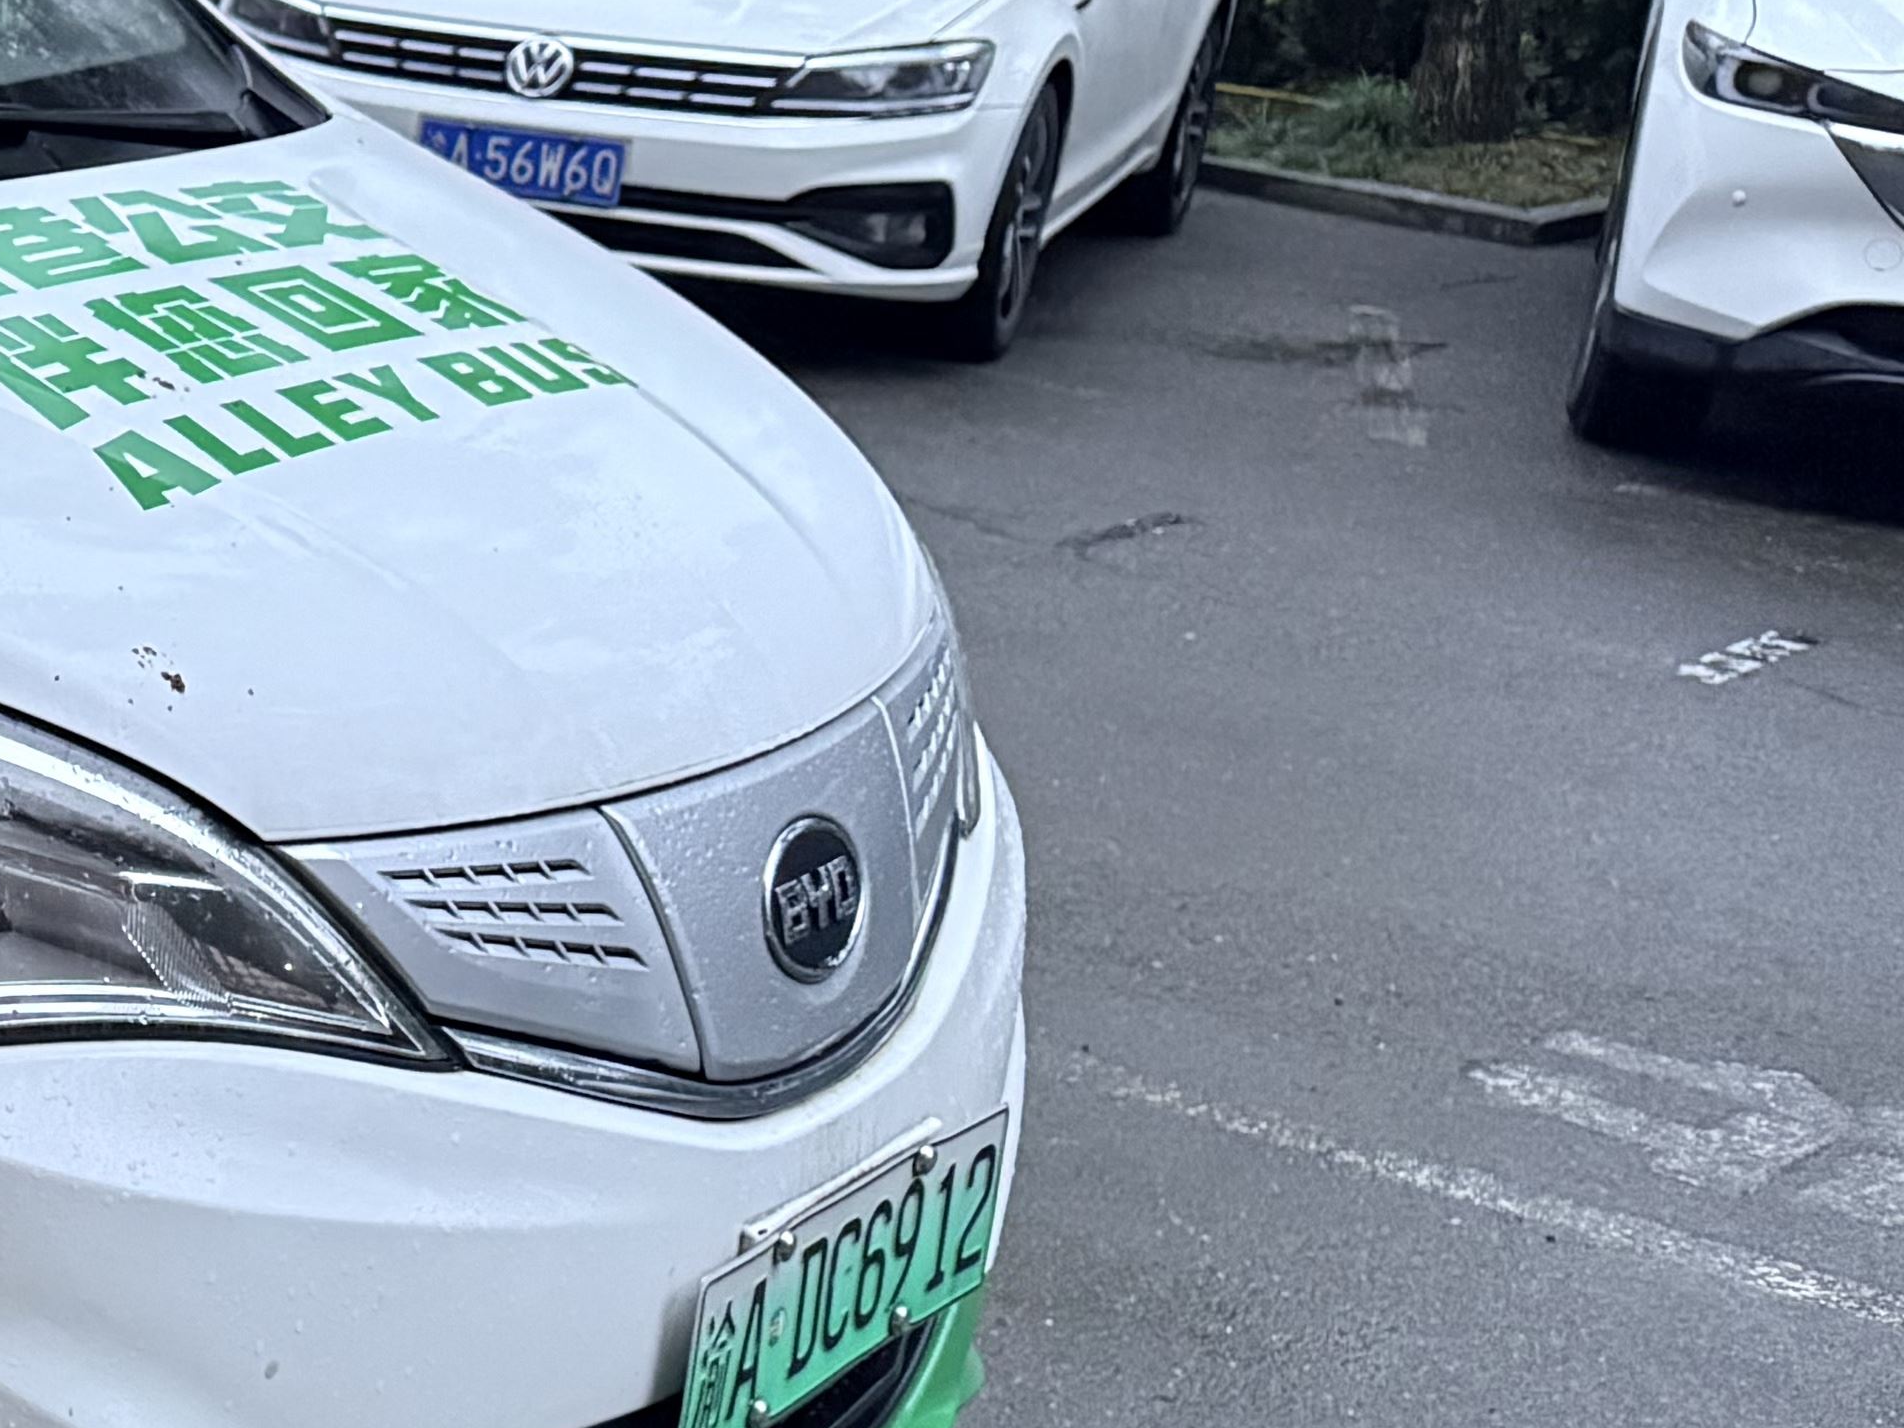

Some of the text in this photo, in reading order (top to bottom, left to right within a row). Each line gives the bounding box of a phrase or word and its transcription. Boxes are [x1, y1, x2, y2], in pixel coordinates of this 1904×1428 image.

[93, 336, 639, 511] ALLEY BUS
[775, 855, 859, 946] BYD
